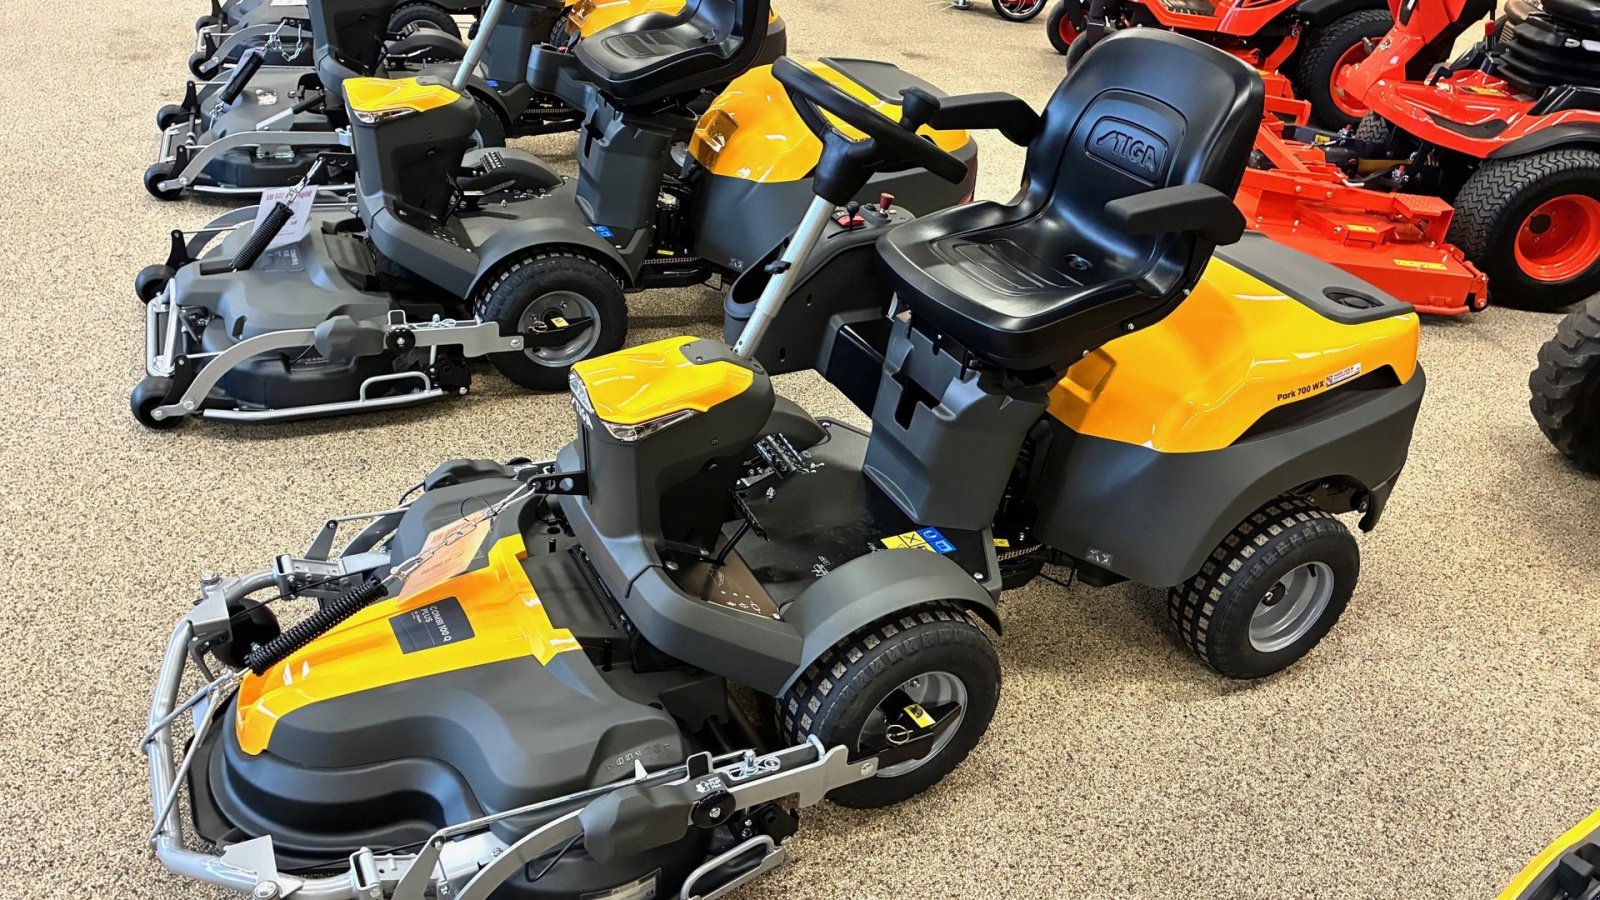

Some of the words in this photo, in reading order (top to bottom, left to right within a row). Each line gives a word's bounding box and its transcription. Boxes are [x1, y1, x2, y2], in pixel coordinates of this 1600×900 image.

[1096, 130, 1157, 172] STIGA
[1277, 390, 1297, 401] Park
[1297, 385, 1311, 396] 700
[1312, 380, 1325, 391] WX
[421, 608, 433, 623] PLUS
[430, 606, 444, 626] COMBI
[438, 624, 450, 635] 100
